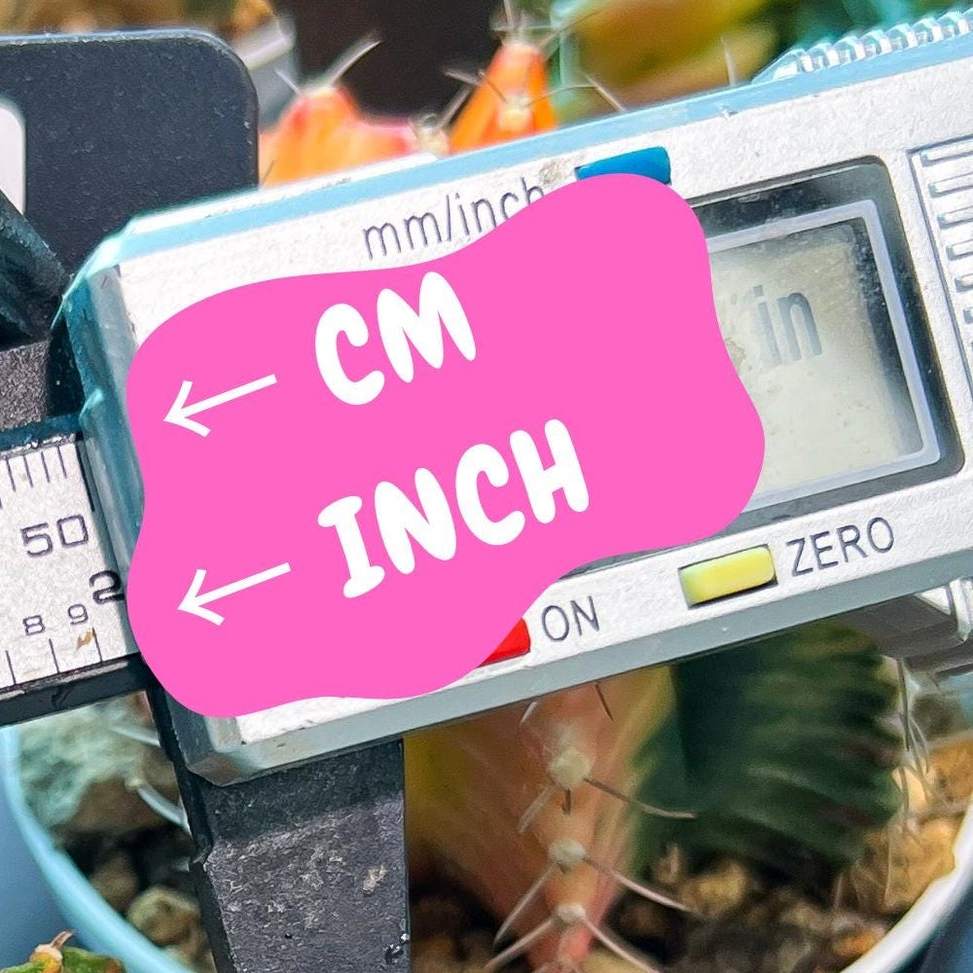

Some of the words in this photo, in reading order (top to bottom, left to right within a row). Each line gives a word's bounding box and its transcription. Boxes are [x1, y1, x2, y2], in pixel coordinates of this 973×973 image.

[20, 514, 89, 558] 50
[785, 516, 896, 577] ZERO
[22, 614, 46, 636] 8
[67, 603, 89, 626] 9
[89, 569, 125, 604] 2
[540, 595, 601, 642] ON
